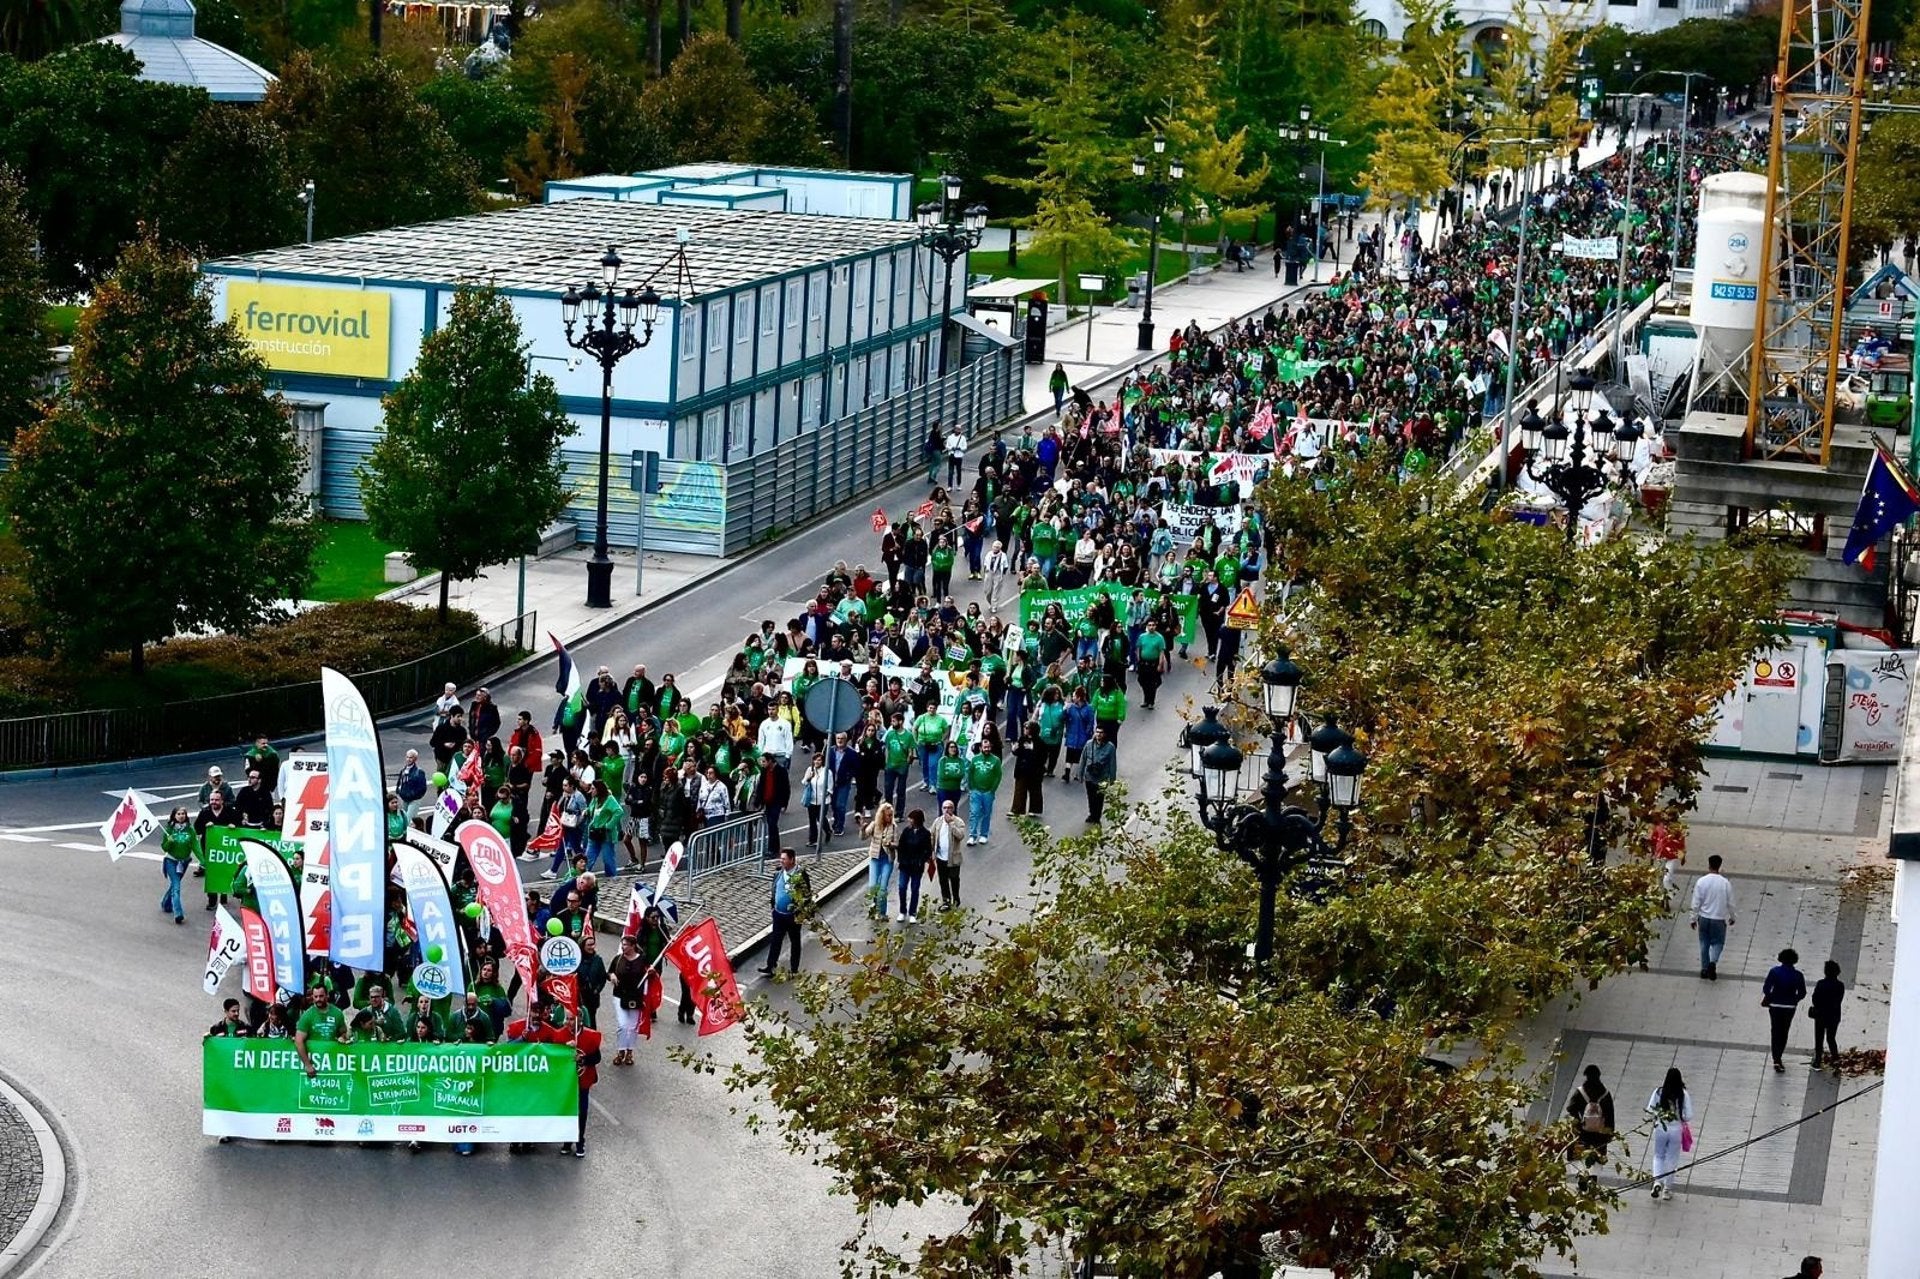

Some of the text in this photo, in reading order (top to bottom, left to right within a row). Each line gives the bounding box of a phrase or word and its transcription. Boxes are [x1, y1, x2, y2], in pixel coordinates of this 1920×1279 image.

[1729, 238, 1746, 247] 294
[1714, 285, 1726, 297] 942
[1727, 286, 1736, 297] 57
[1737, 287, 1746, 298] 52
[245, 301, 370, 339] ferrovial
[293, 760, 328, 771] STE
[435, 802, 453, 823] STEC
[222, 836, 237, 847] En
[546, 957, 577, 968] ANPE
[685, 935, 716, 988] UG
[417, 980, 447, 994] ANPE
[234, 1049, 255, 1069] EN
[336, 1053, 357, 1072] DE
[361, 1054, 381, 1072] LA
[385, 1051, 476, 1073] EDUCACIÓN
[481, 1051, 549, 1073] PÚBLICA
[311, 1078, 341, 1090] BAJADA
[443, 1077, 475, 1092] STOP
[309, 1095, 337, 1106] RATIOS
[448, 1125, 467, 1134] UGT
